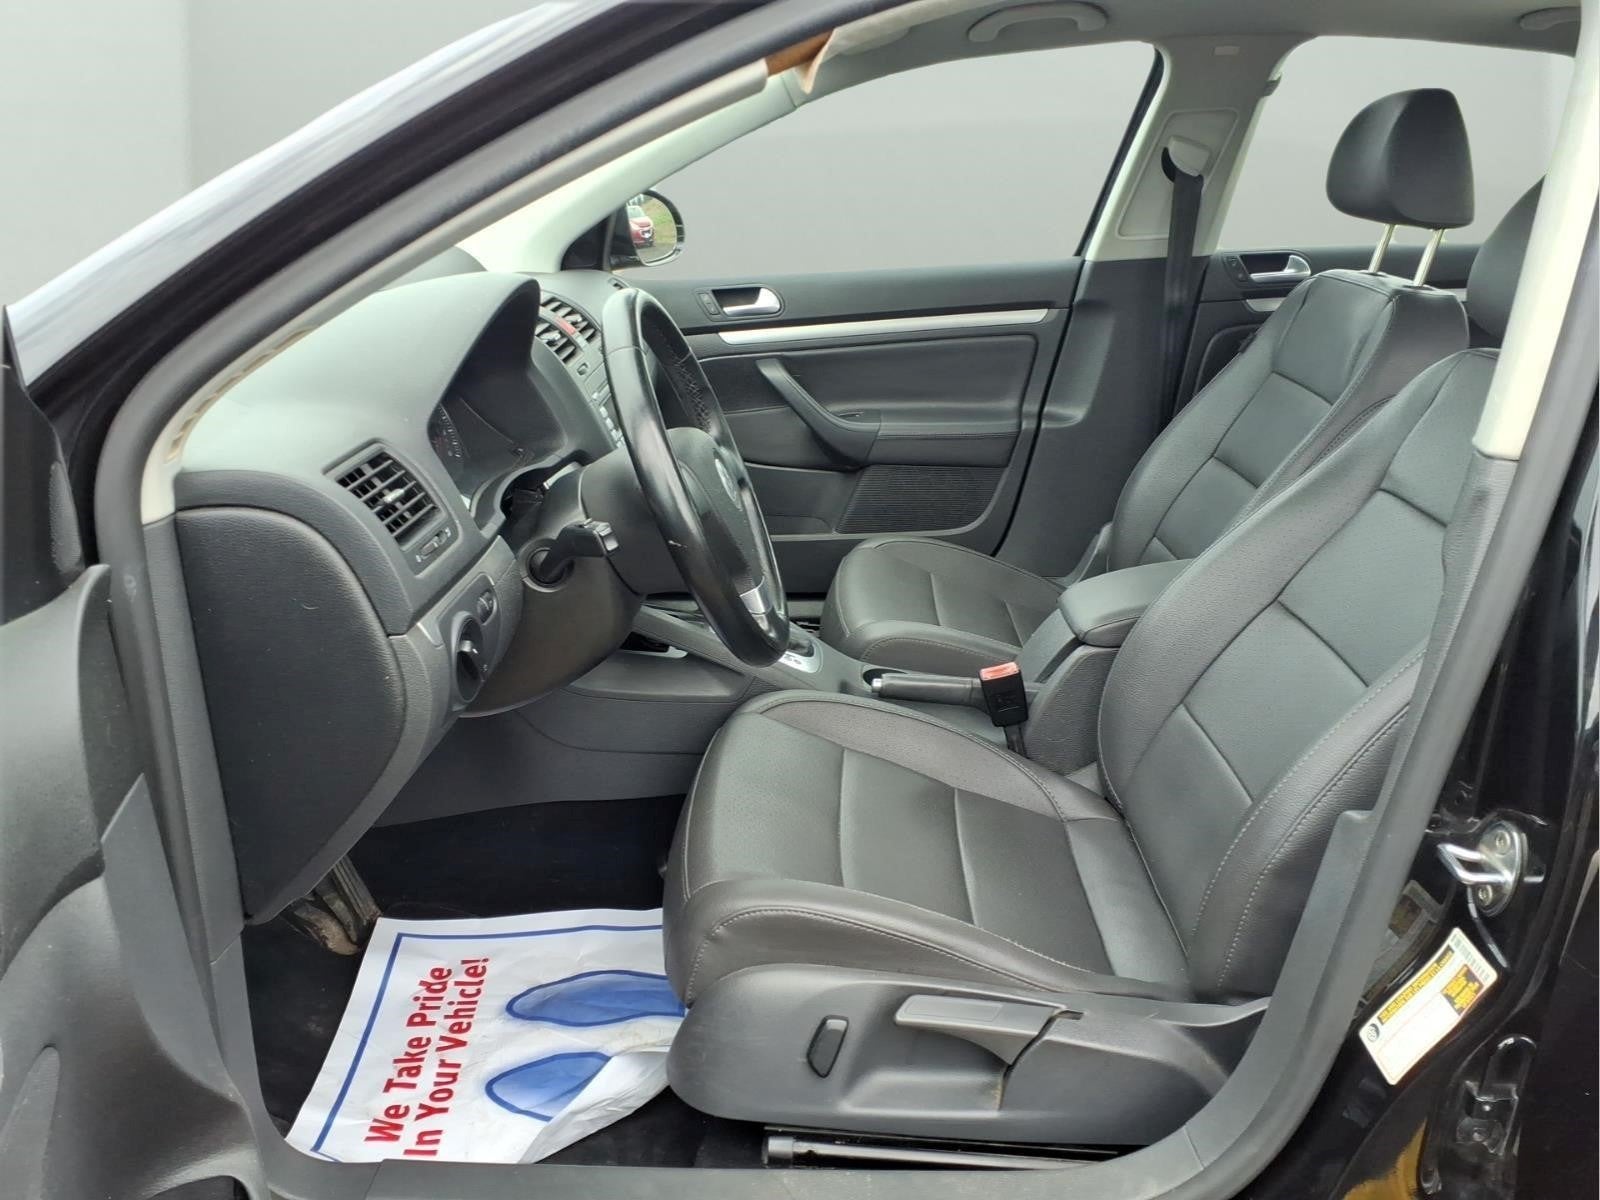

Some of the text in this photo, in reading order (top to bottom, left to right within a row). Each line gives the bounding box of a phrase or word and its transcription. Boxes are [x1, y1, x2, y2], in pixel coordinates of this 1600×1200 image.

[365, 967, 452, 1143] We Take Pride
[404, 959, 489, 1156] In Your Vehicle!
